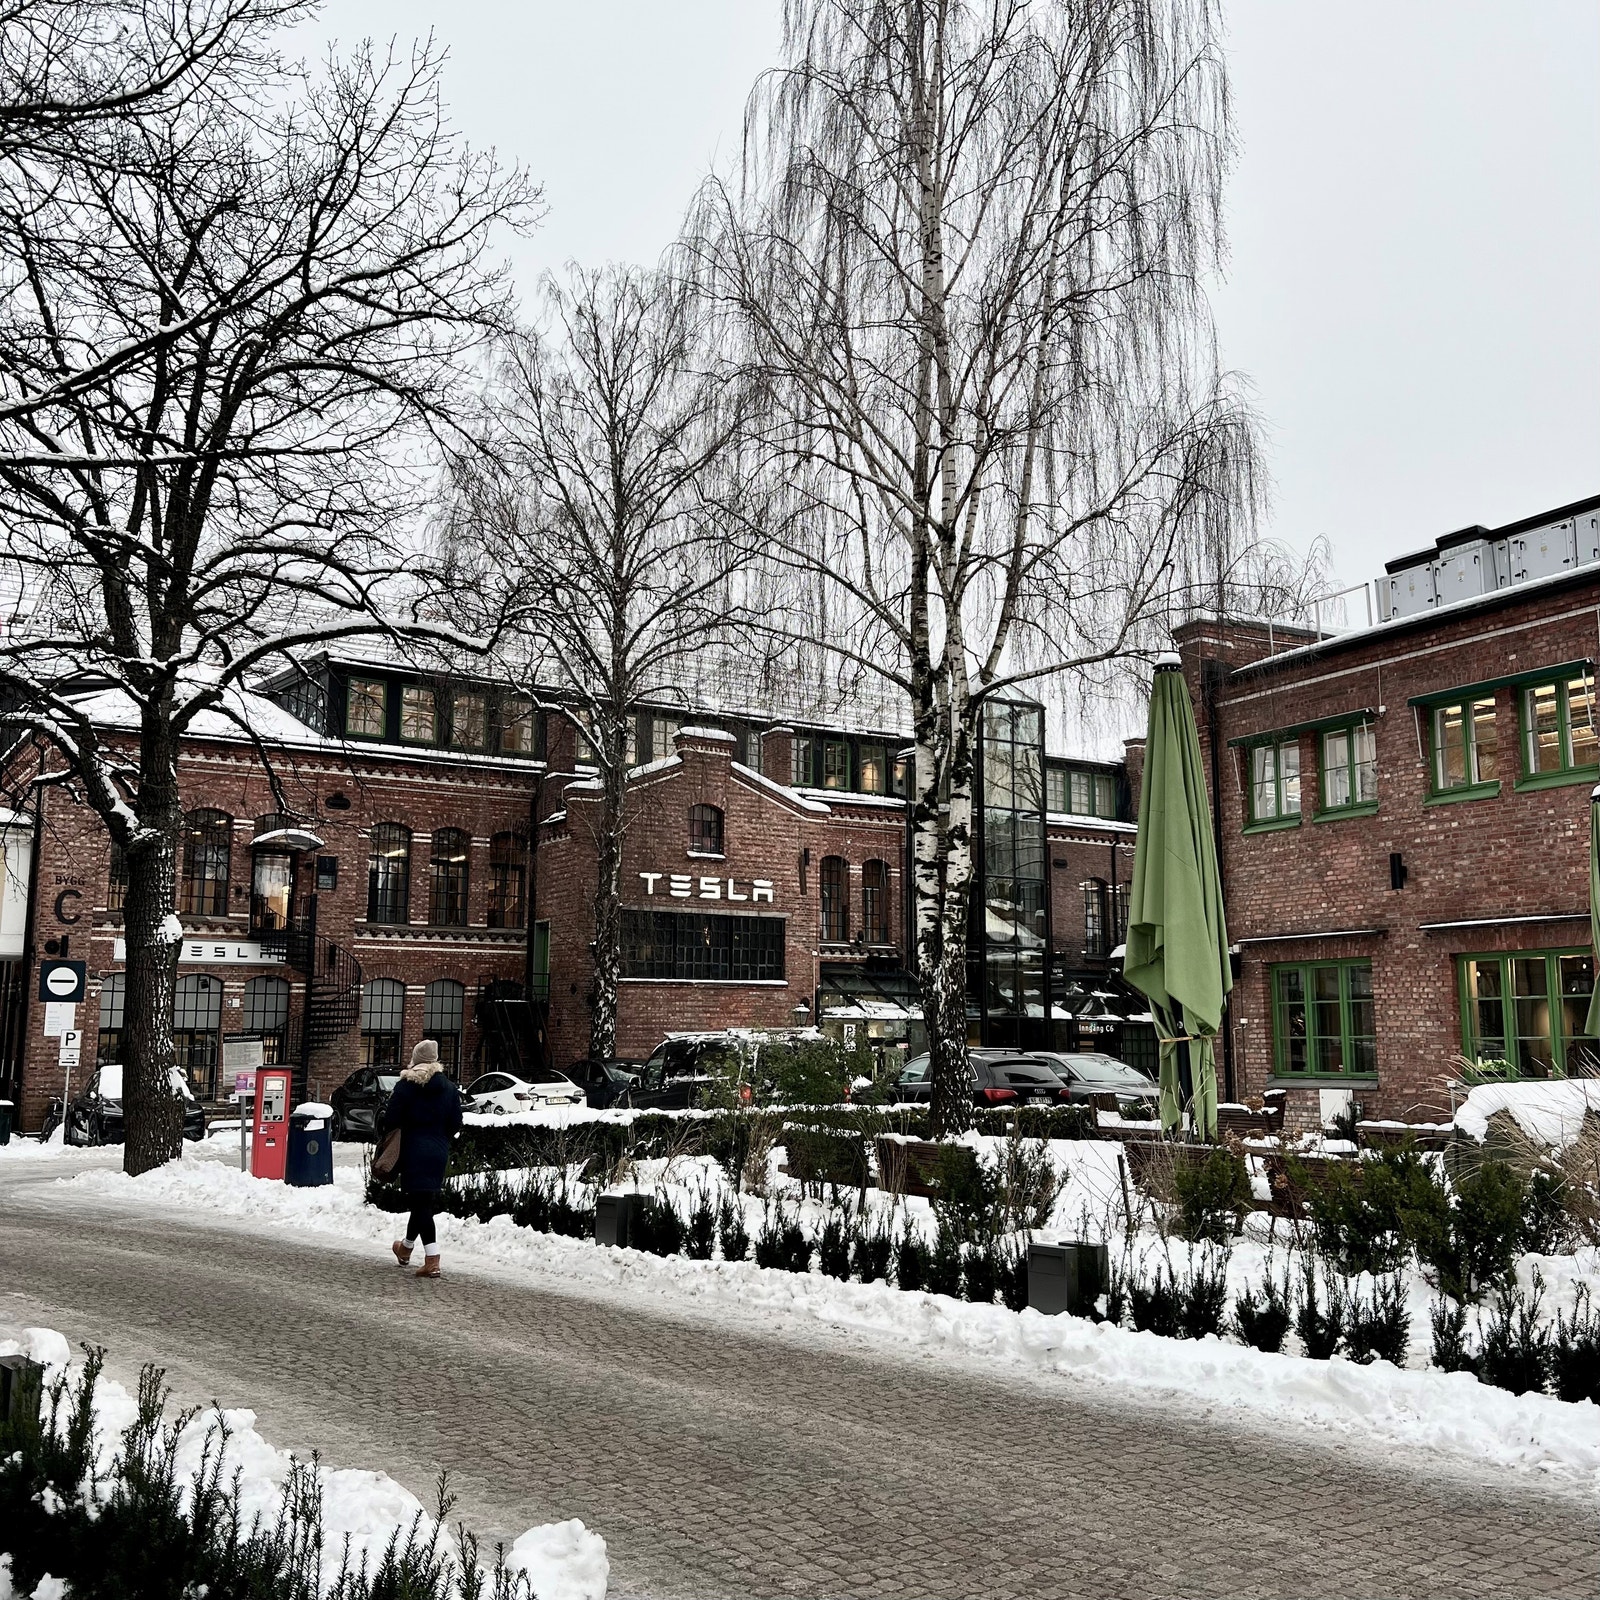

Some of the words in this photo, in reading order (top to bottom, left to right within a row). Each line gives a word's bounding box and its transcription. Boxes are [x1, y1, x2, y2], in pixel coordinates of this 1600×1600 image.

[55, 875, 85, 886] BYGG
[639, 872, 774, 903] TESLA
[54, 889, 82, 925] C
[1105, 1024, 1114, 1032] C6
[65, 1032, 76, 1046] P
